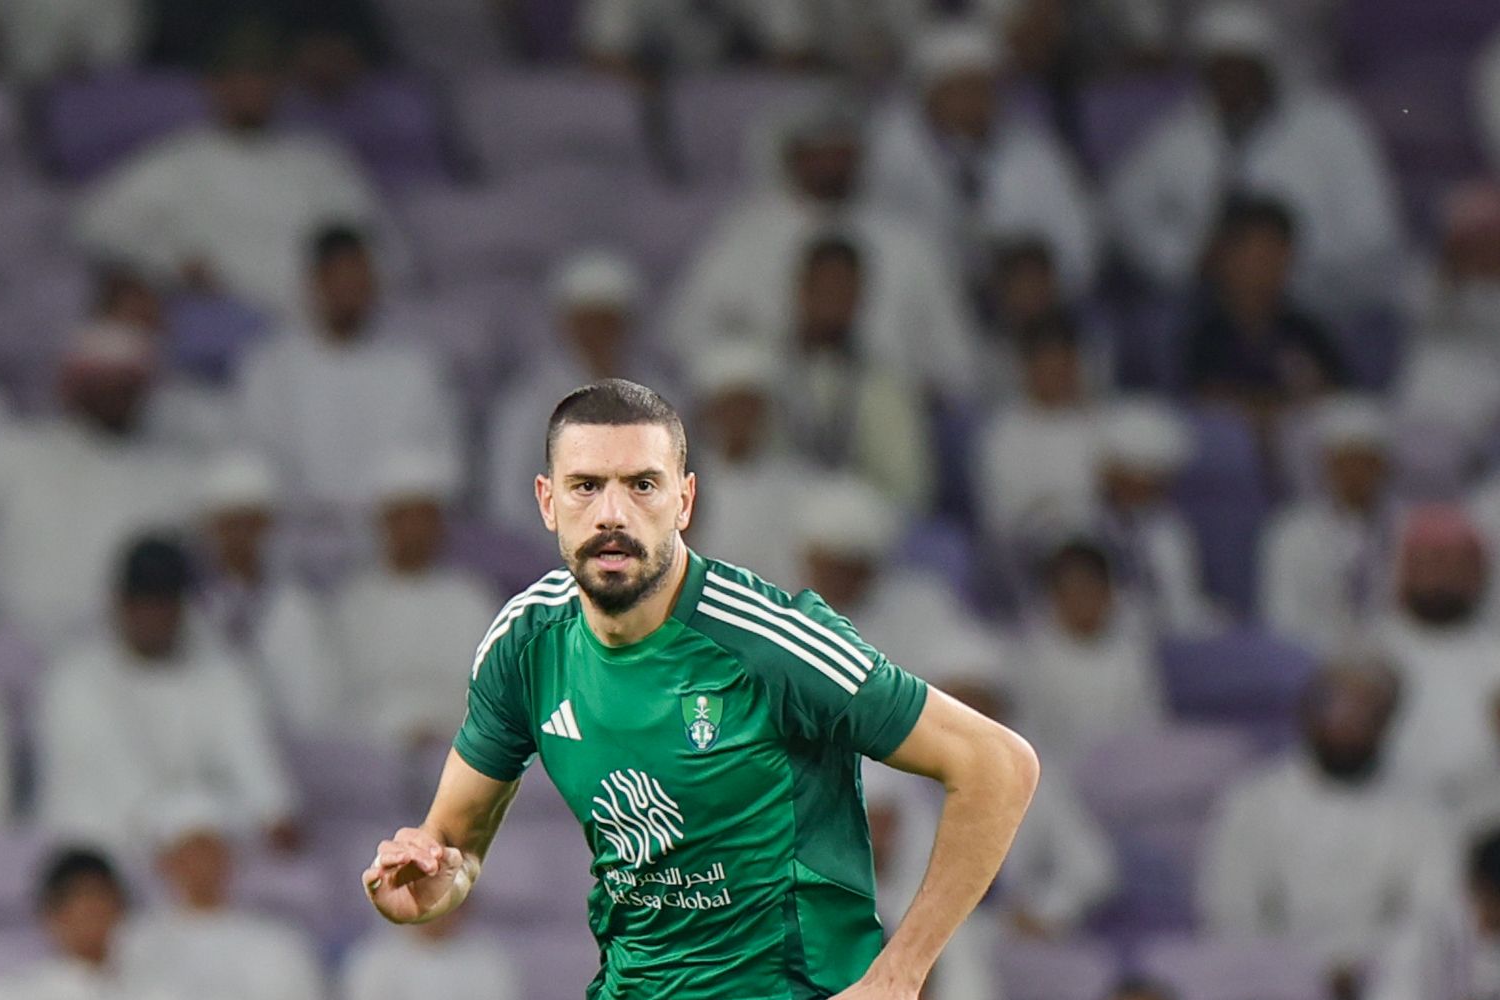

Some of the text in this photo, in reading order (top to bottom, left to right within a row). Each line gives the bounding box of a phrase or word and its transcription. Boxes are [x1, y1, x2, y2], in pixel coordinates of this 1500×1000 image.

[684, 862, 726, 889] البحر
[629, 891, 662, 910] Sea
[663, 888, 732, 910] Global
